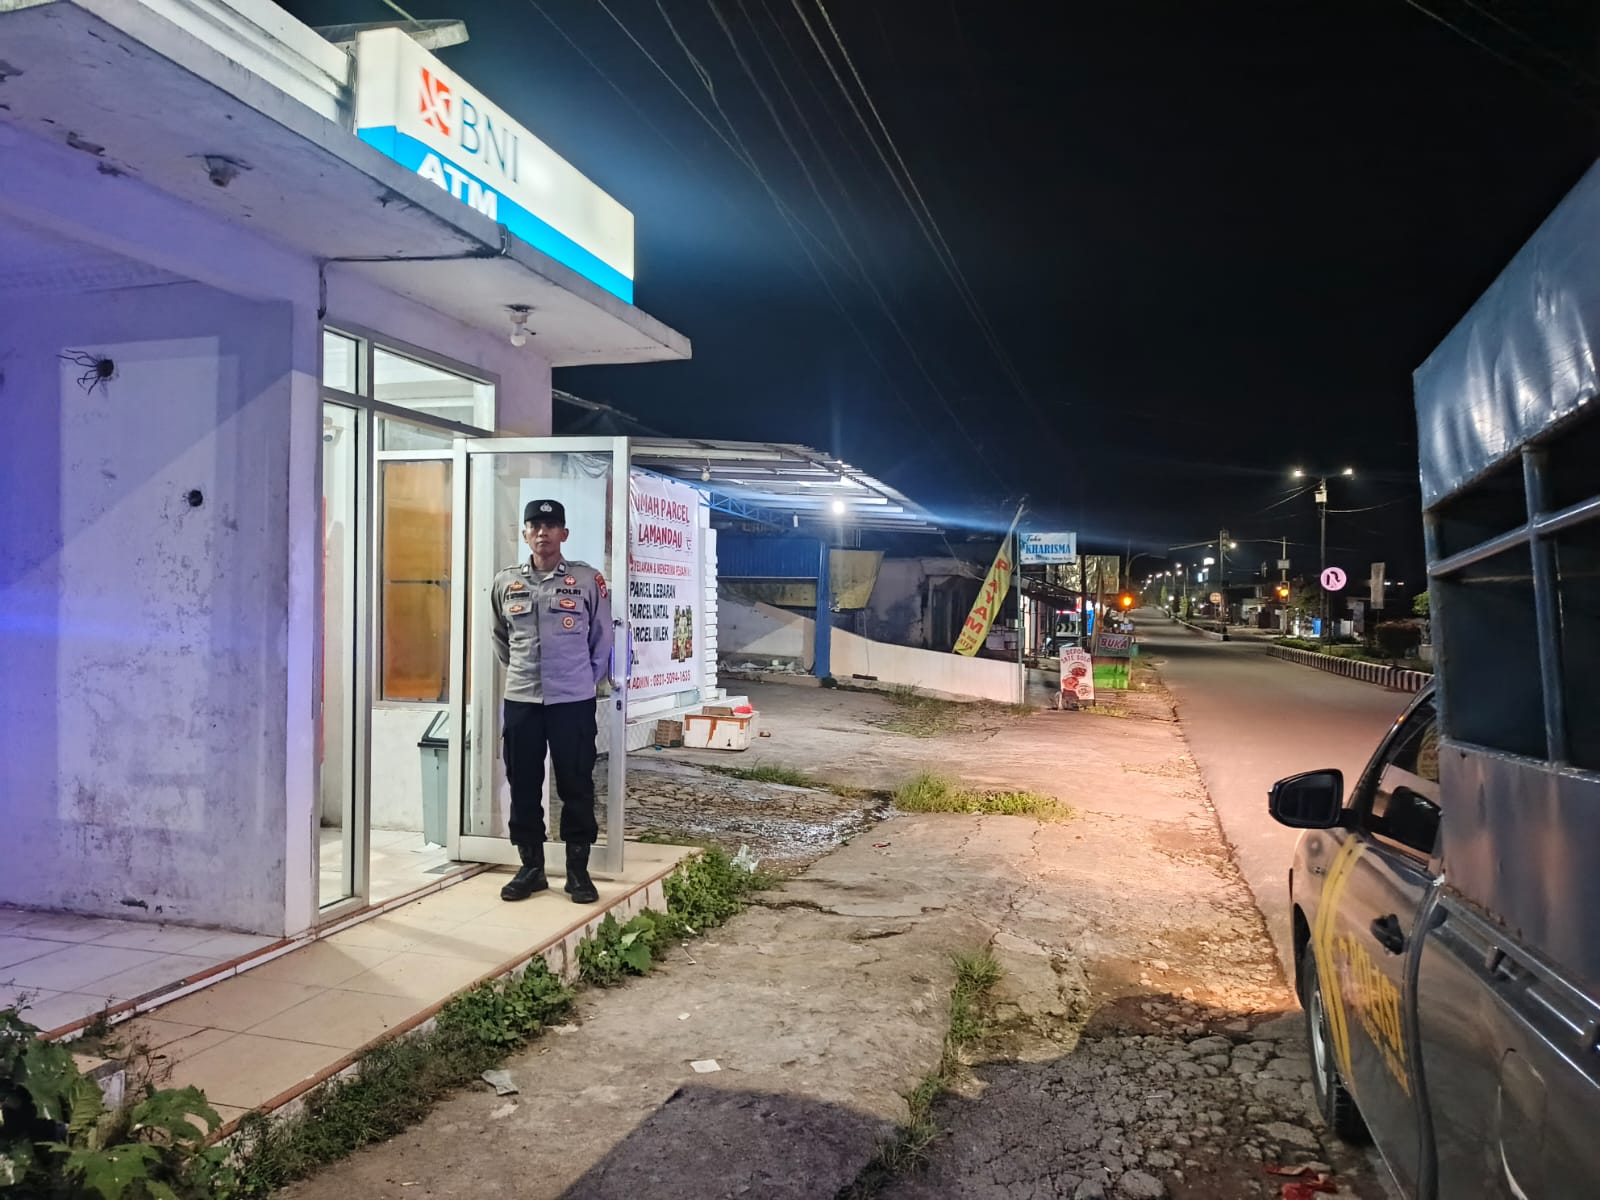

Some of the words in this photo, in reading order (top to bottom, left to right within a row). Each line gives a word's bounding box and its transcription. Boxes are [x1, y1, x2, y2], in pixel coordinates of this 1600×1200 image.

[460, 97, 519, 184] BNI
[416, 152, 498, 221] ATM
[634, 494, 659, 516] UMAH
[661, 498, 690, 523] PARCEL
[638, 523, 682, 548] LAMANDAU
[1025, 544, 1071, 554] KHARISMA
[556, 588, 581, 596] POLRI
[630, 581, 652, 599] PARCEL
[653, 583, 676, 599] LEBARAN
[630, 603, 653, 620] PARCEL
[653, 604, 669, 620] NATAL
[1100, 637, 1128, 649] BUKA
